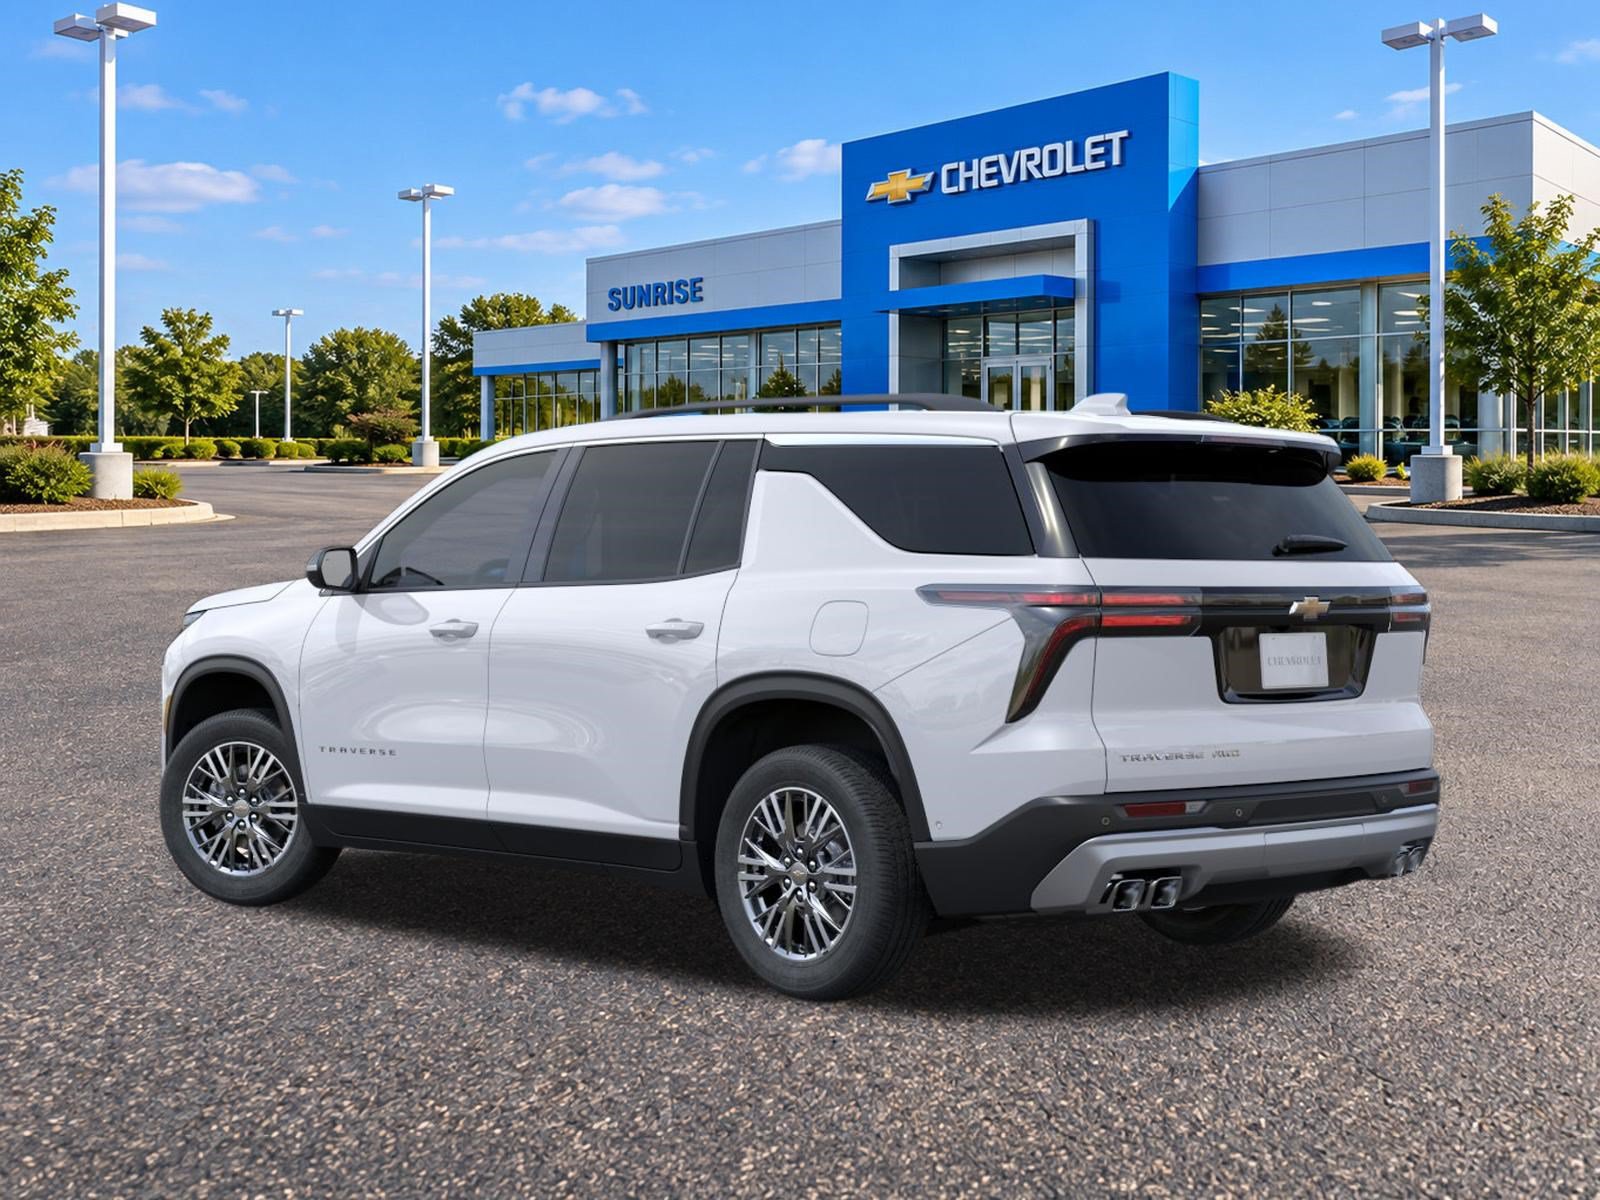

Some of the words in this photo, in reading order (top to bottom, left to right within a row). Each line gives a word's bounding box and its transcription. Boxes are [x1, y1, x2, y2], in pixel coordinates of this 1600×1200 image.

[941, 130, 1128, 194] CHEVROLET
[608, 277, 704, 311] SUNRISE
[319, 746, 397, 756] TRAVERSE
[1120, 752, 1204, 762] TRAVERSE
